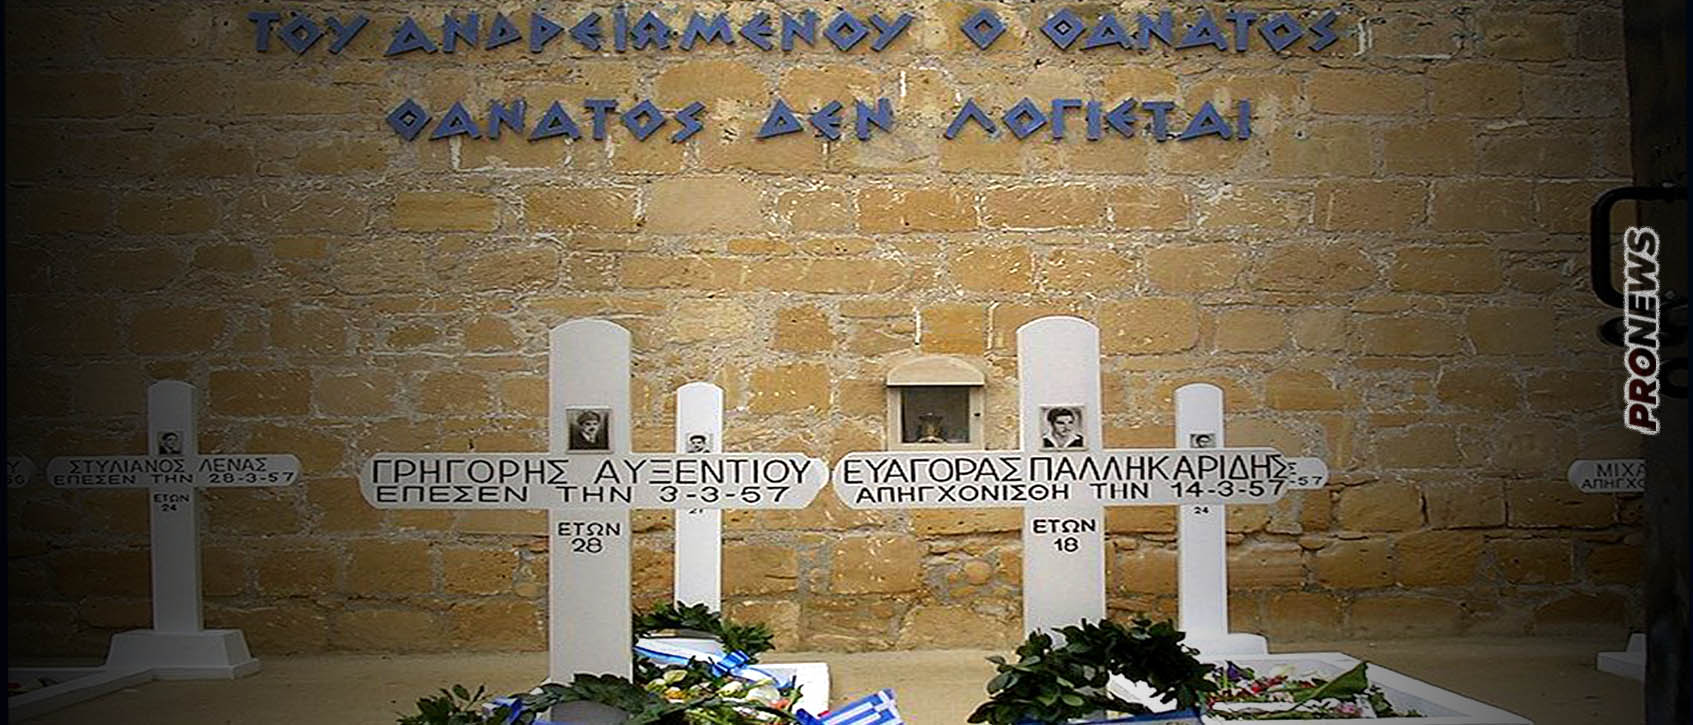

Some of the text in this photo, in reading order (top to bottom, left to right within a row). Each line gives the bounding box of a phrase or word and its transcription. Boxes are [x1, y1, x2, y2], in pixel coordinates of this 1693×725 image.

[247, 7, 1340, 57] ΤΟΥ ΑΝΔΡΕΙΩΜΕΝΟΥ Ο ΘΑΝΑΤΟΣ
[386, 97, 1253, 142] ΘΑΝΑΤΟΣ ΔΕΝ ΛΟΓΙΕΤΑΙ
[69, 457, 268, 474] ΣΤΥΛΙΑΝΟΣ ΛΕΝΑΣ
[372, 458, 812, 485] ΓΡΗΓΟΡΗΣ ΑΥΞΕΝΤΙΟΥ
[843, 454, 1289, 484] ΕΥΑΓΟΡΑΣ ΠΑΛΛΗΚΑΡΙΔΗΣ
[53, 471, 294, 486] ΕΠΕΣΕΝ ΤΗΝ 28-3-57
[376, 486, 790, 503] ΕΠΕΣΕΝ ΤΗΝ 3-3-57
[855, 479, 1285, 504] ΑΠΗΓΧΟΝΙΣΘΗ ΤΗΝ 14-3-57
[161, 503, 177, 512] 24
[1193, 506, 1209, 514] 24
[557, 522, 621, 537] ΕΤΩΝ
[1033, 518, 1096, 535] ΕΤΩΝ
[572, 538, 603, 554] 28
[1053, 537, 1079, 553] 18
